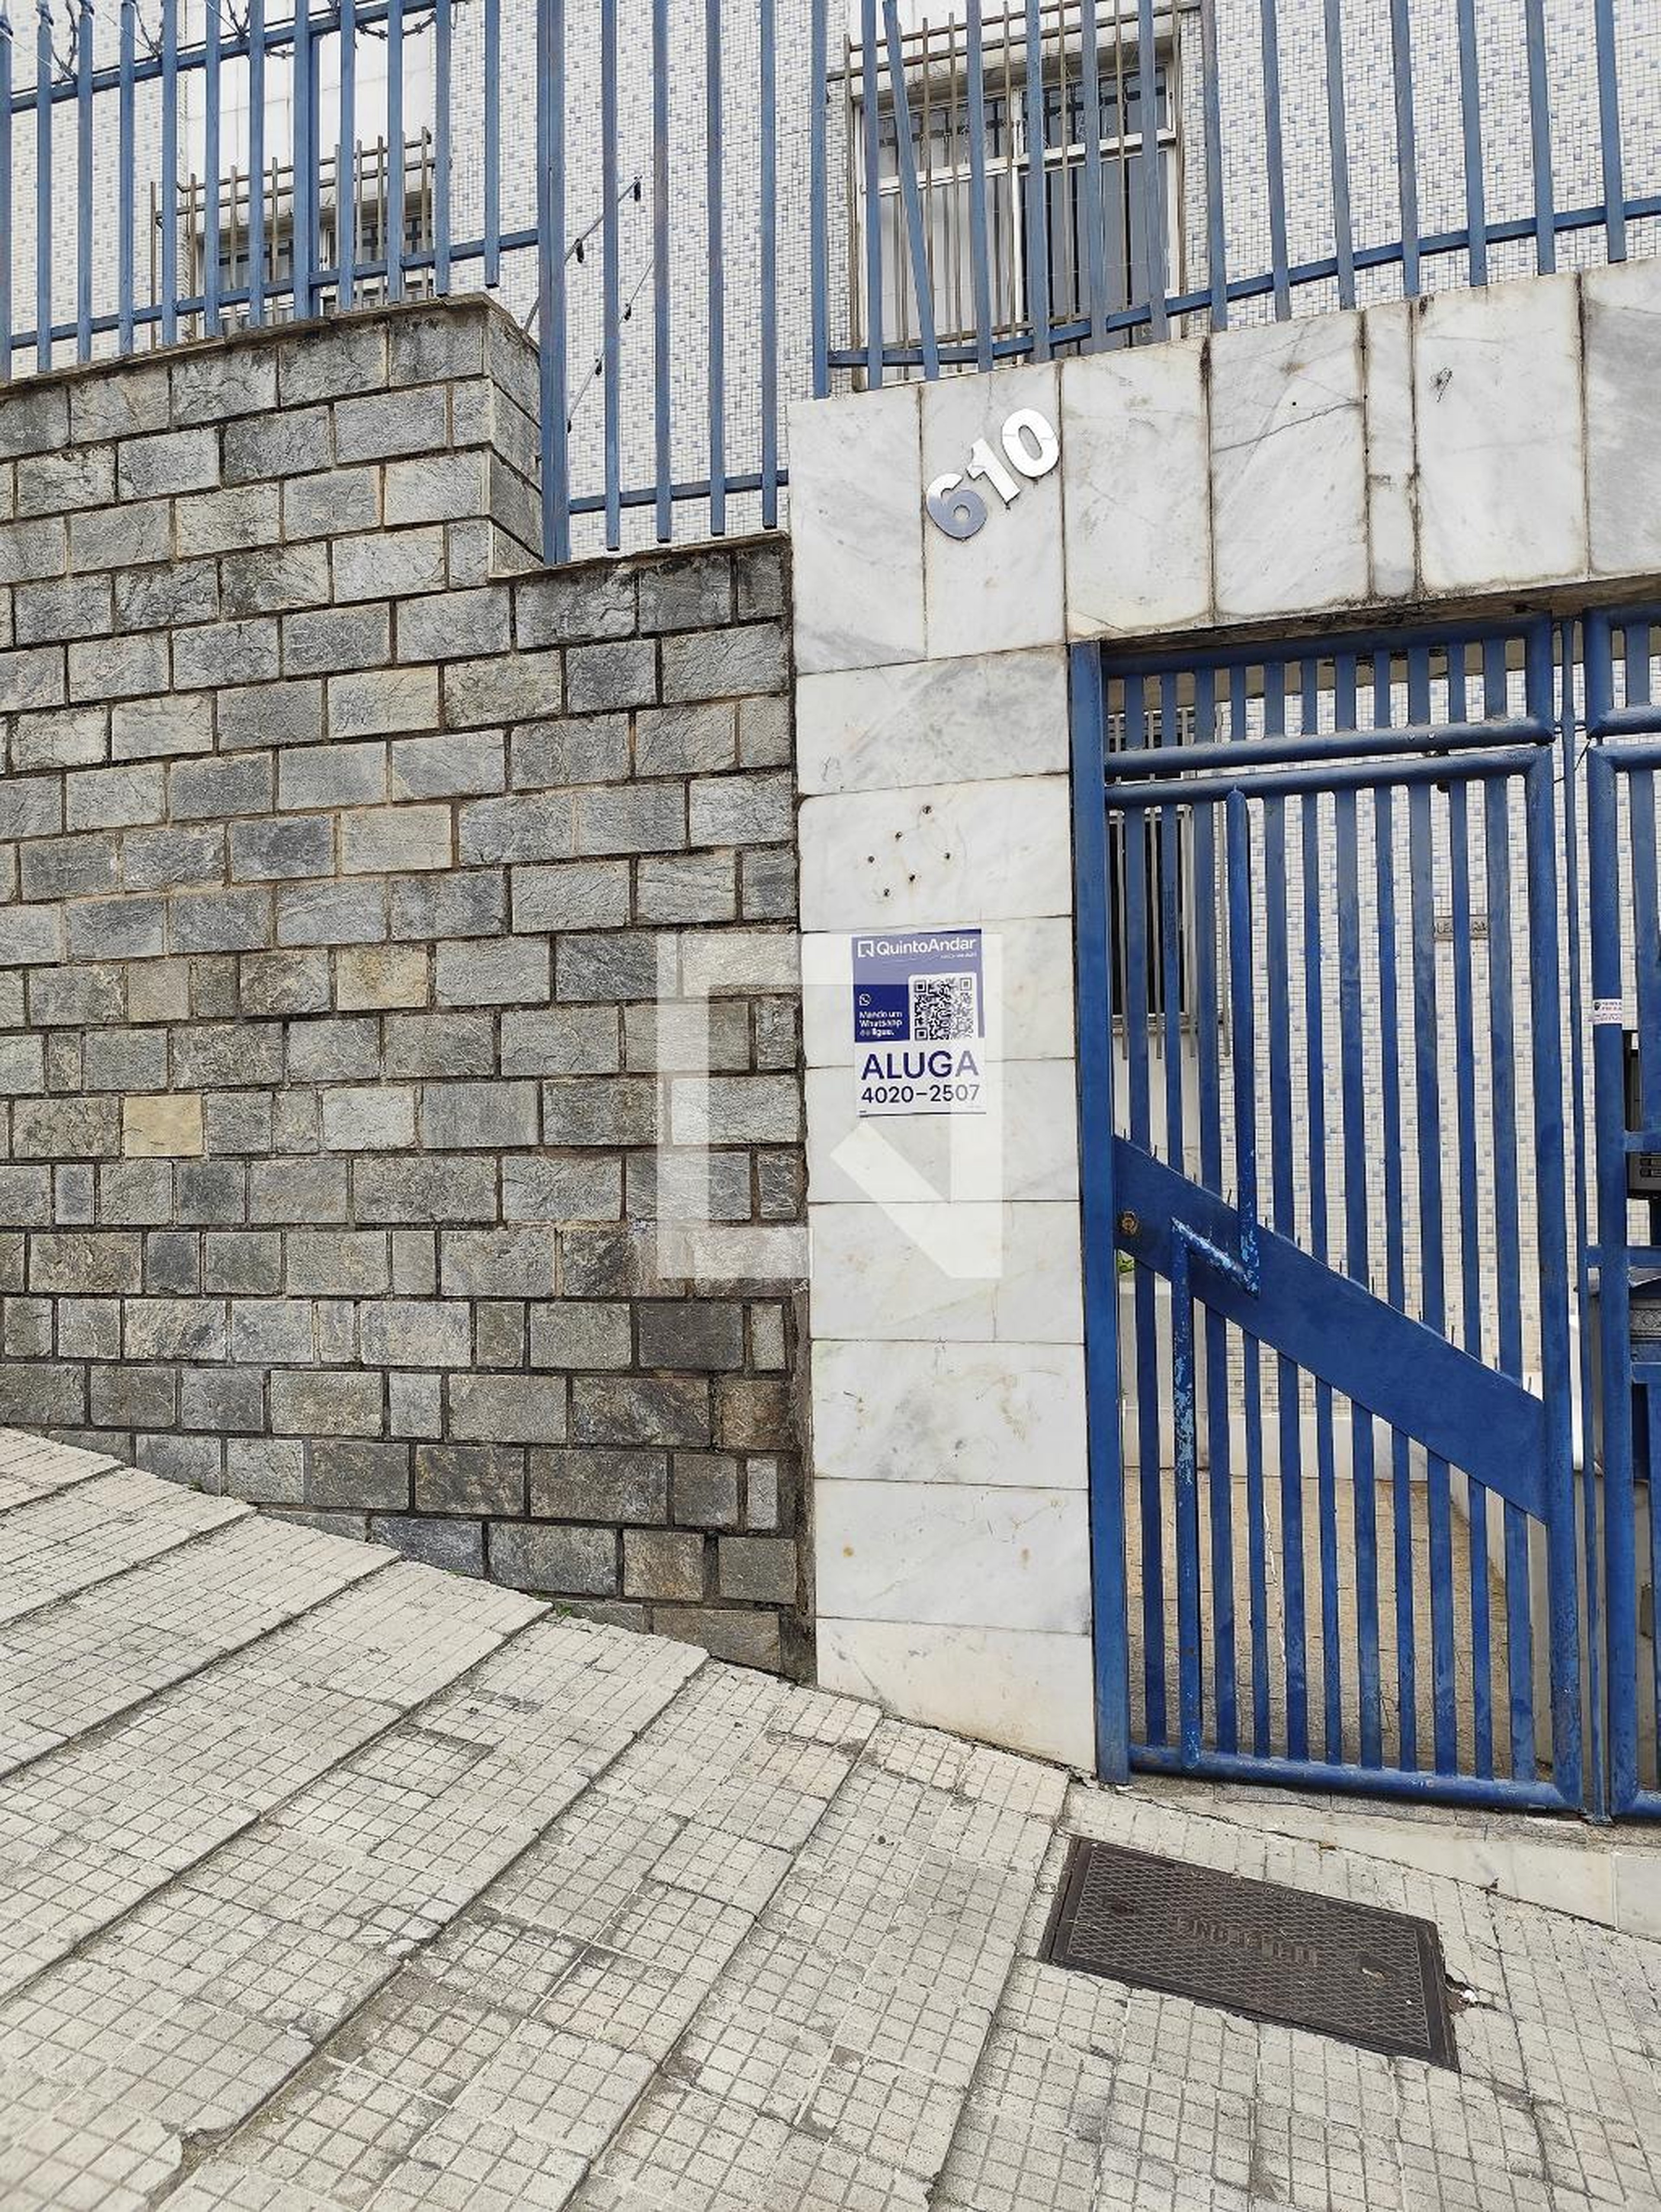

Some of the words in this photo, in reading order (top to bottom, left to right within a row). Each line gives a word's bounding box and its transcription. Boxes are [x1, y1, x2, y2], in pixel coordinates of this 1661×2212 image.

[926, 409, 1060, 541] 610
[876, 937, 977, 956] QuintoAndar
[861, 1050, 979, 1080] ALUGA
[861, 1084, 980, 1103] 4020-2507
